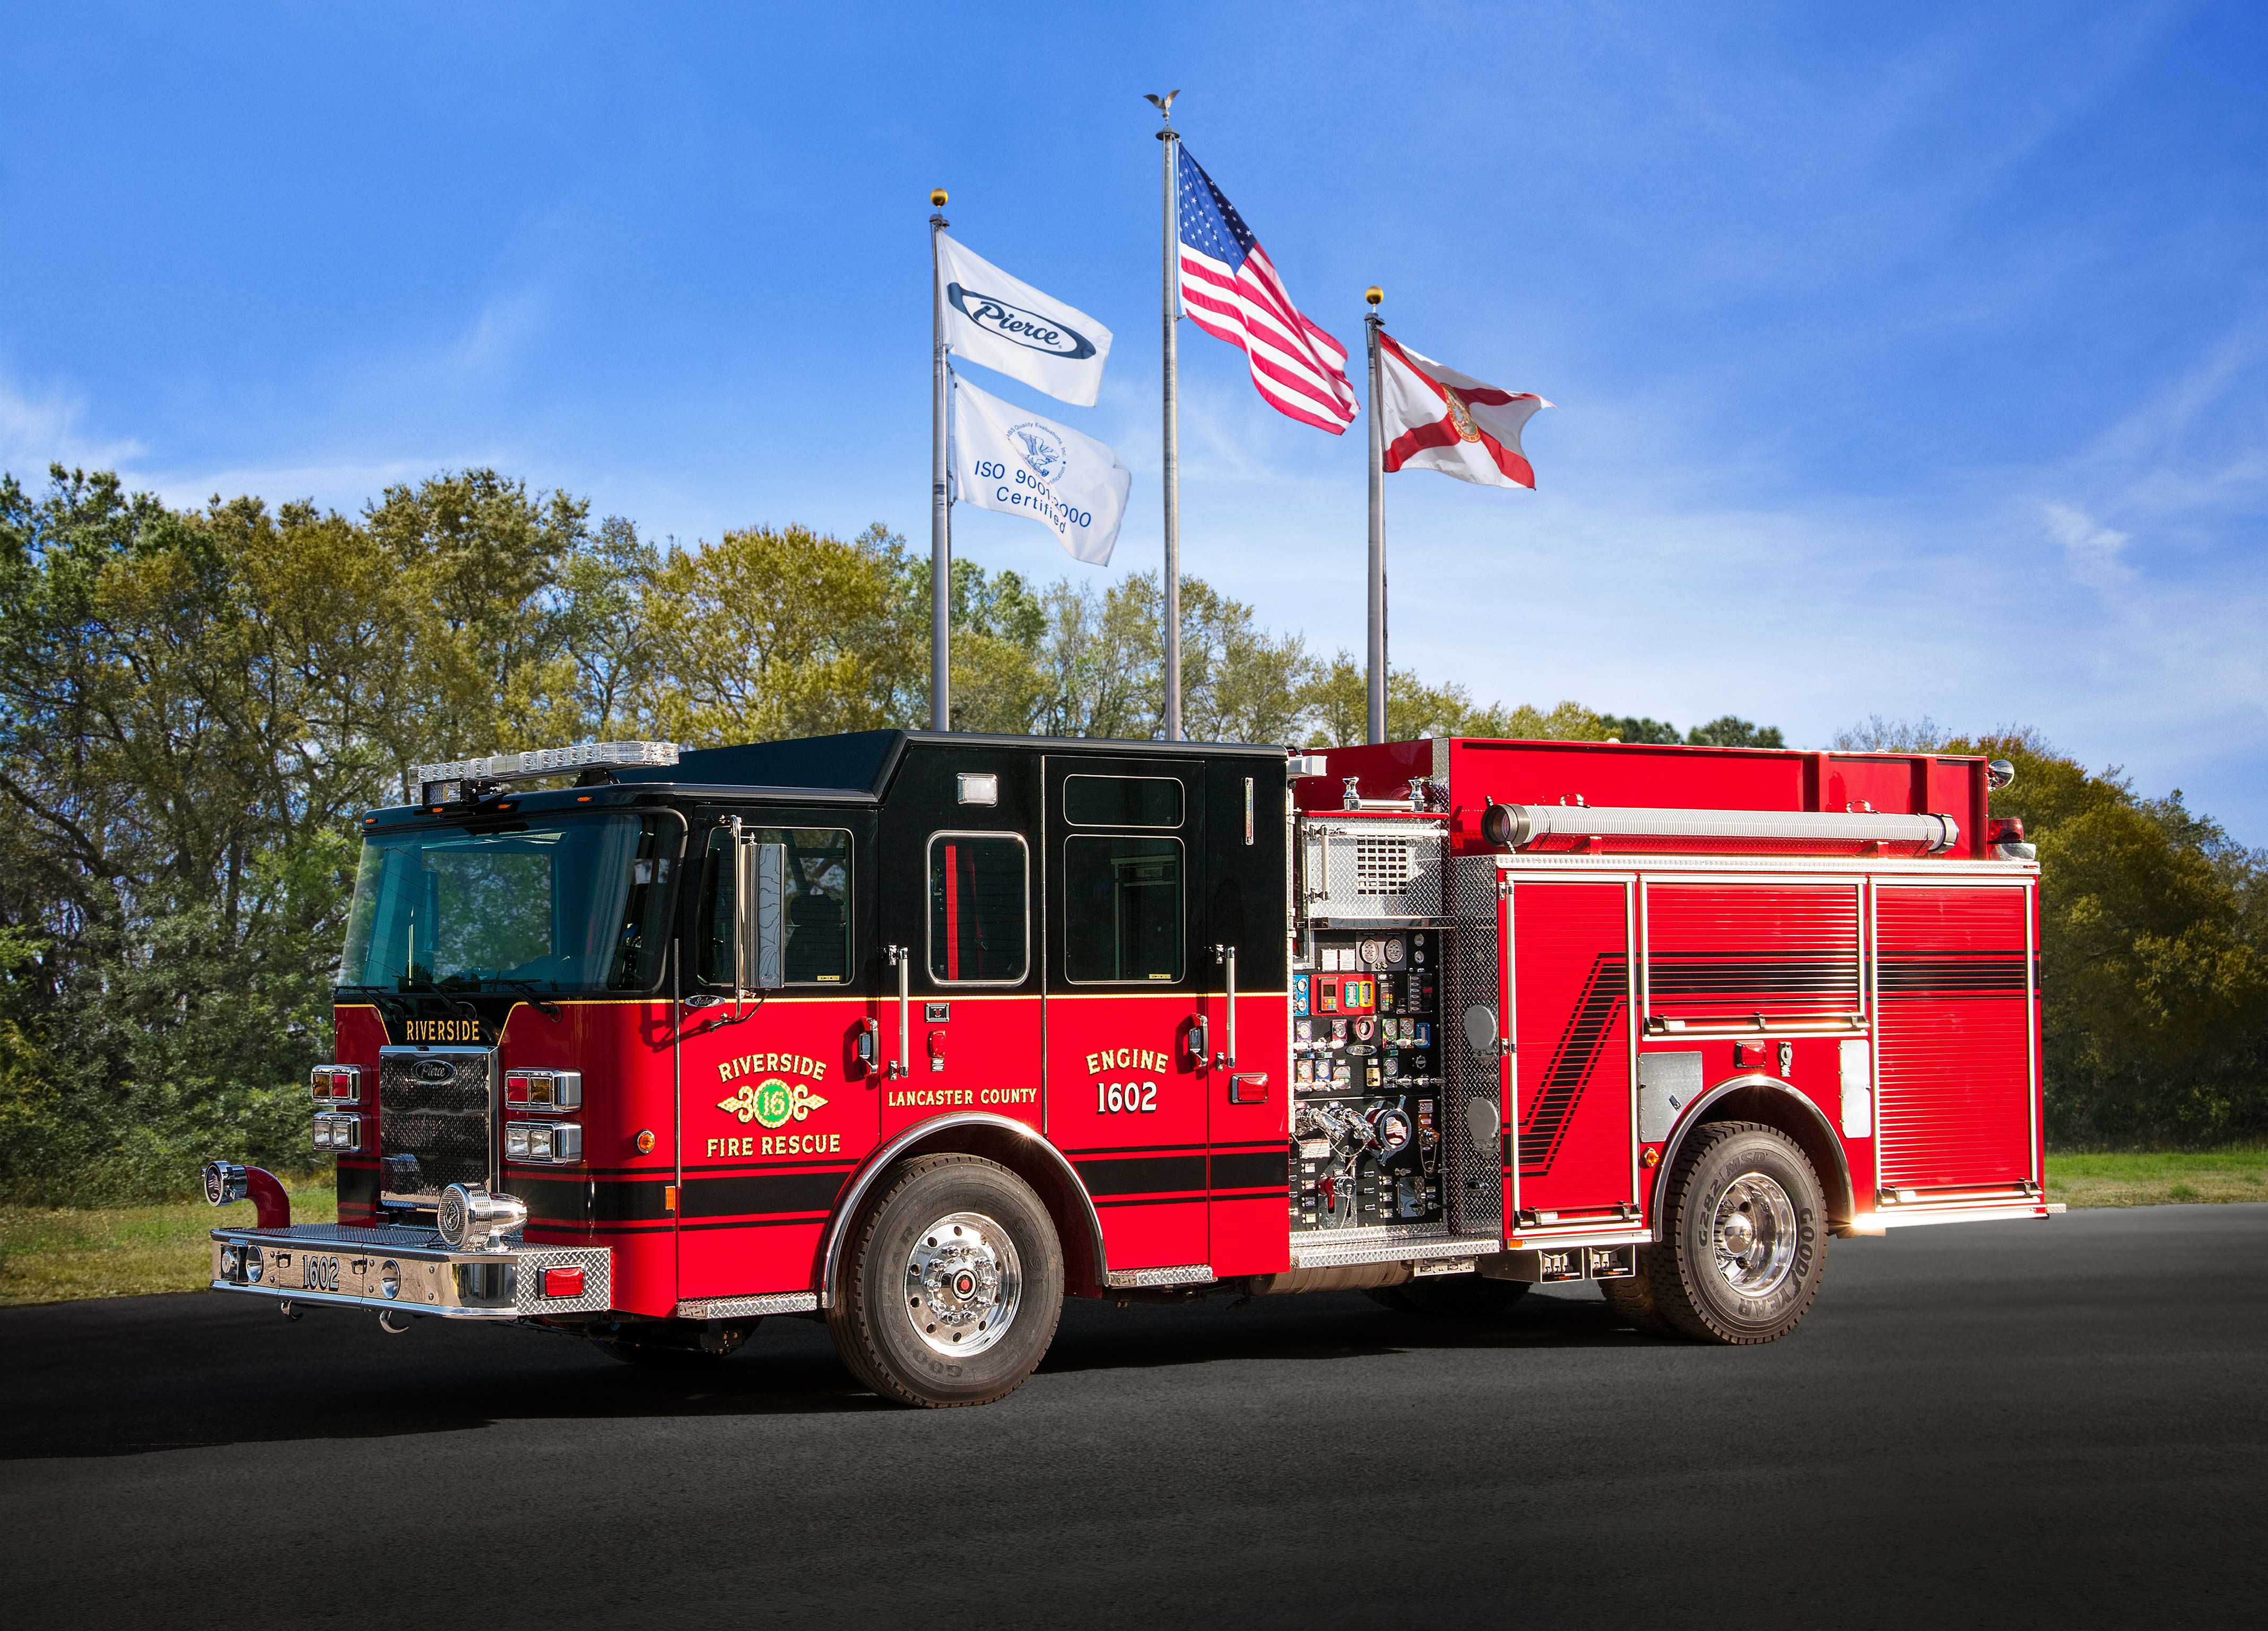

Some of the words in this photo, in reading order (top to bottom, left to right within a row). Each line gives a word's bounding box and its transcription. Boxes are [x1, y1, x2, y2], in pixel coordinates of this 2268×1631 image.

[972, 301, 1060, 345] Pierce
[1014, 422, 1033, 430] Quality
[975, 460, 1005, 479] ISO
[997, 486, 1066, 534] Certified
[407, 1020, 480, 1041] RIVERSIDE
[717, 1053, 827, 1083] RIVERSIDE
[1086, 1048, 1168, 1075] ENGINE
[762, 1091, 785, 1116] 16
[888, 1089, 974, 1106] LANCASTER
[980, 1088, 1037, 1104] COUNTY
[1097, 1081, 1157, 1114] 1602
[706, 1138, 753, 1157] FIRE
[761, 1134, 841, 1155] RESCUE
[302, 1255, 340, 1291] 1602
